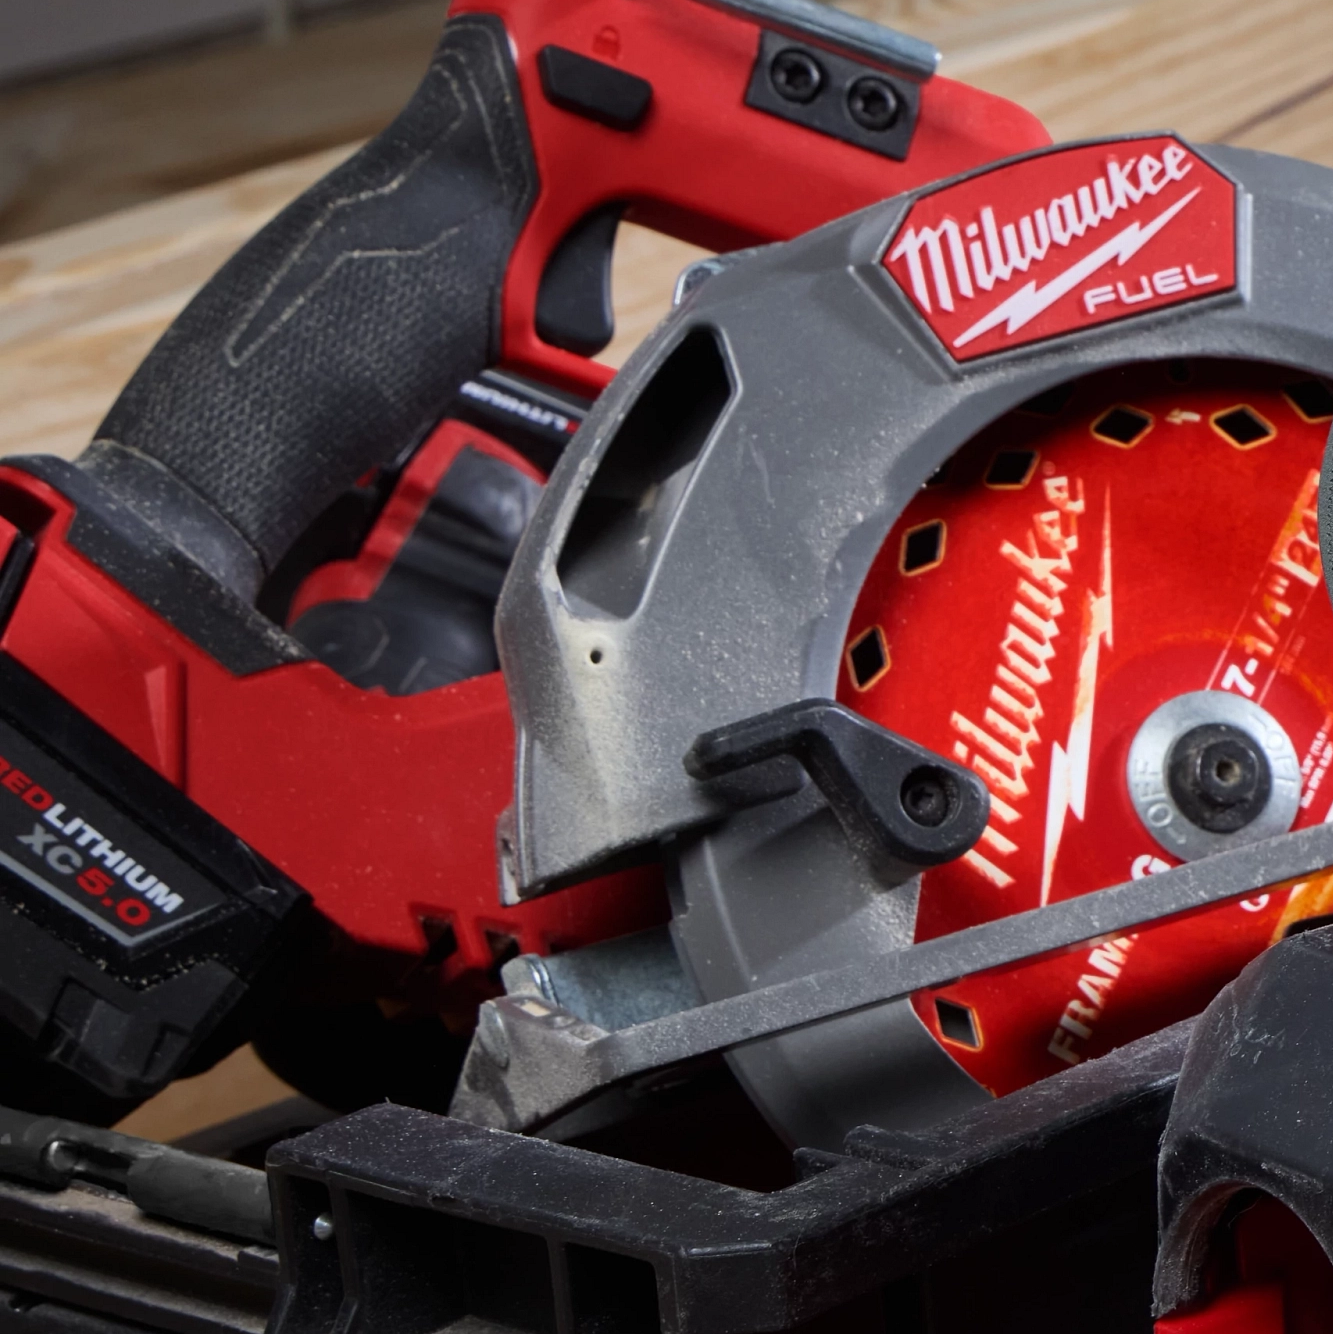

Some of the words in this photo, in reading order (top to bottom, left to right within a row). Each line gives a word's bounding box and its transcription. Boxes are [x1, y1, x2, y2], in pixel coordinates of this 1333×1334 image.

[890, 141, 1191, 314] Milwaukee
[1082, 264, 1220, 314] FUEL
[1047, 854, 1172, 1065] FRAMG
